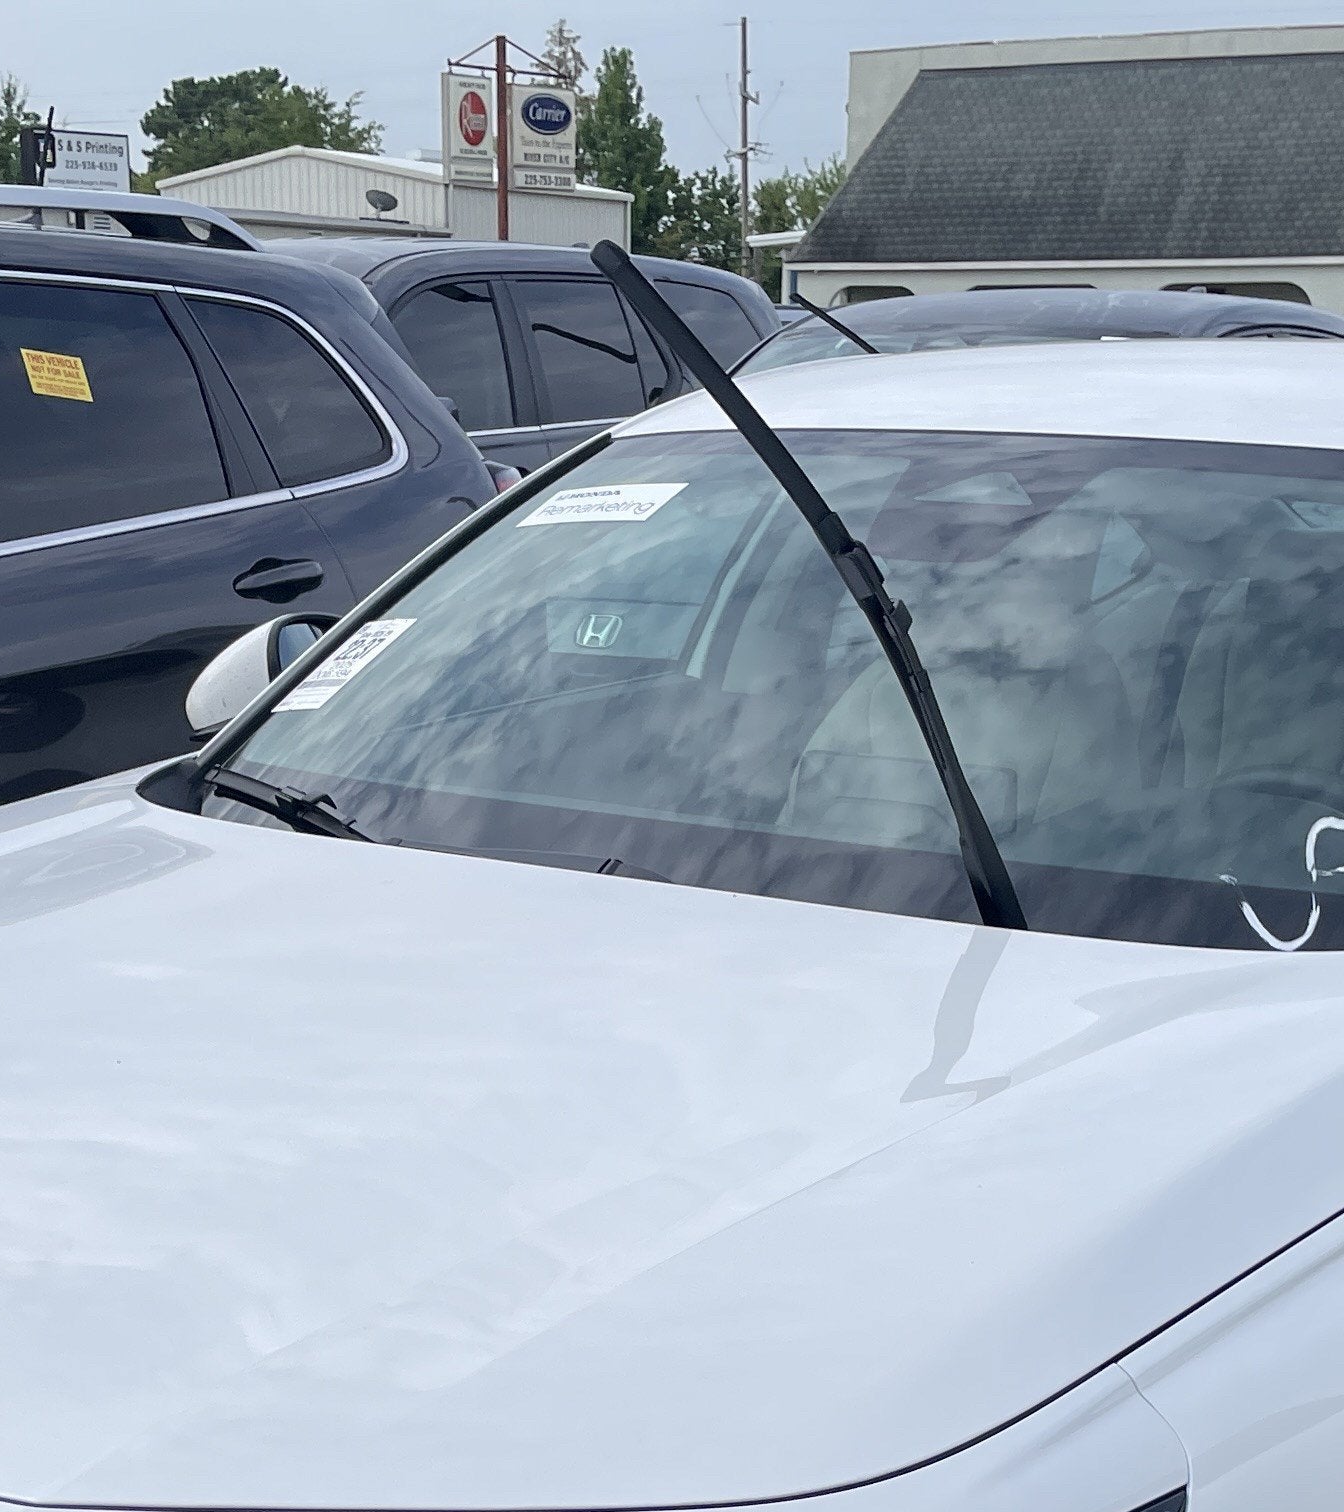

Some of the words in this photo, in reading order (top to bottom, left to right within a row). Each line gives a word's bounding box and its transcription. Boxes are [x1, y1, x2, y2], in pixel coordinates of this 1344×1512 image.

[529, 102, 566, 121] Carrier
[58, 139, 63, 151] S
[66, 140, 73, 152] &
[76, 140, 82, 152] S
[86, 141, 124, 157] Printing
[45, 356, 80, 370] VEHICLE
[30, 364, 44, 374] NOT
[47, 366, 62, 376] FOR
[63, 369, 82, 380] SALE
[536, 500, 655, 516] Remarketing
